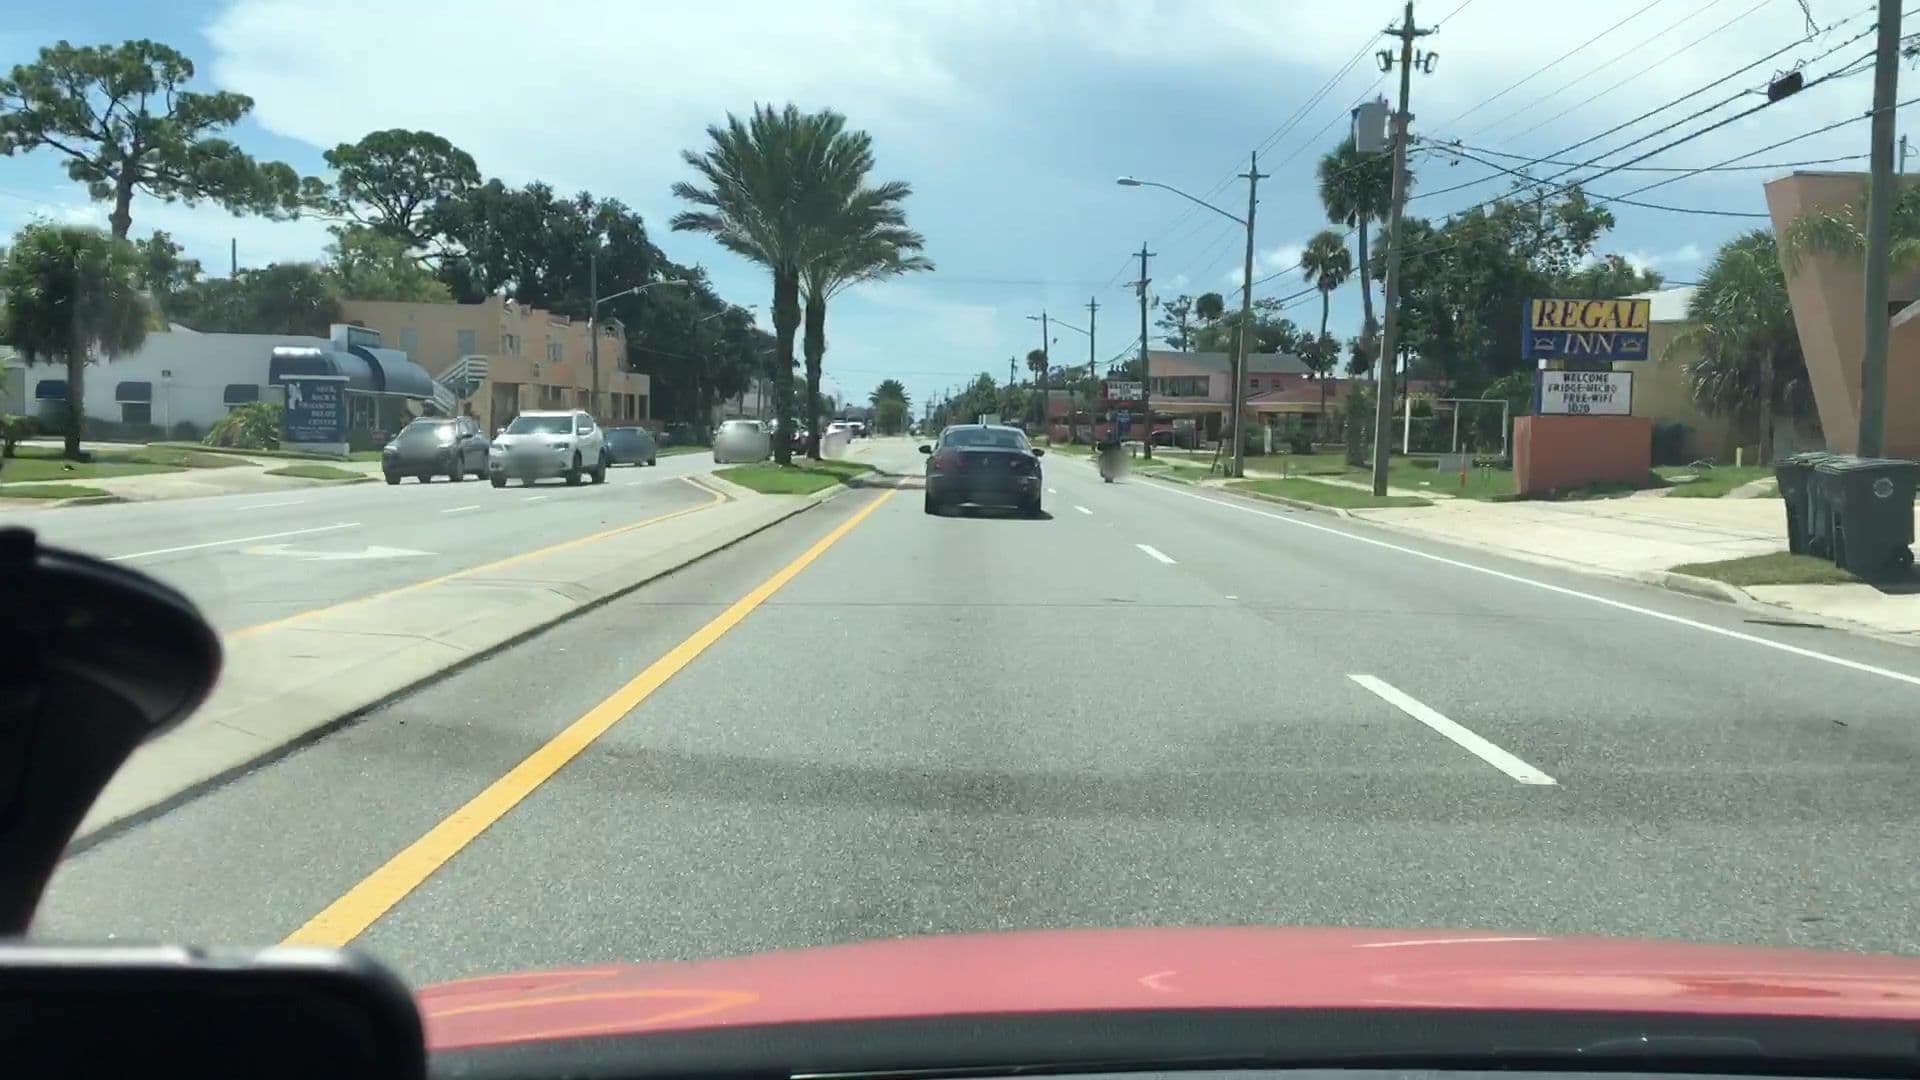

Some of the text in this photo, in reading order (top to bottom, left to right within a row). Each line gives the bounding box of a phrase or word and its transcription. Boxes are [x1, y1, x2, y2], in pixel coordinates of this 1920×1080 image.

[1536, 301, 1643, 329] REGAL
[1564, 333, 1616, 354] INN
[1563, 373, 1609, 383] WELCOME
